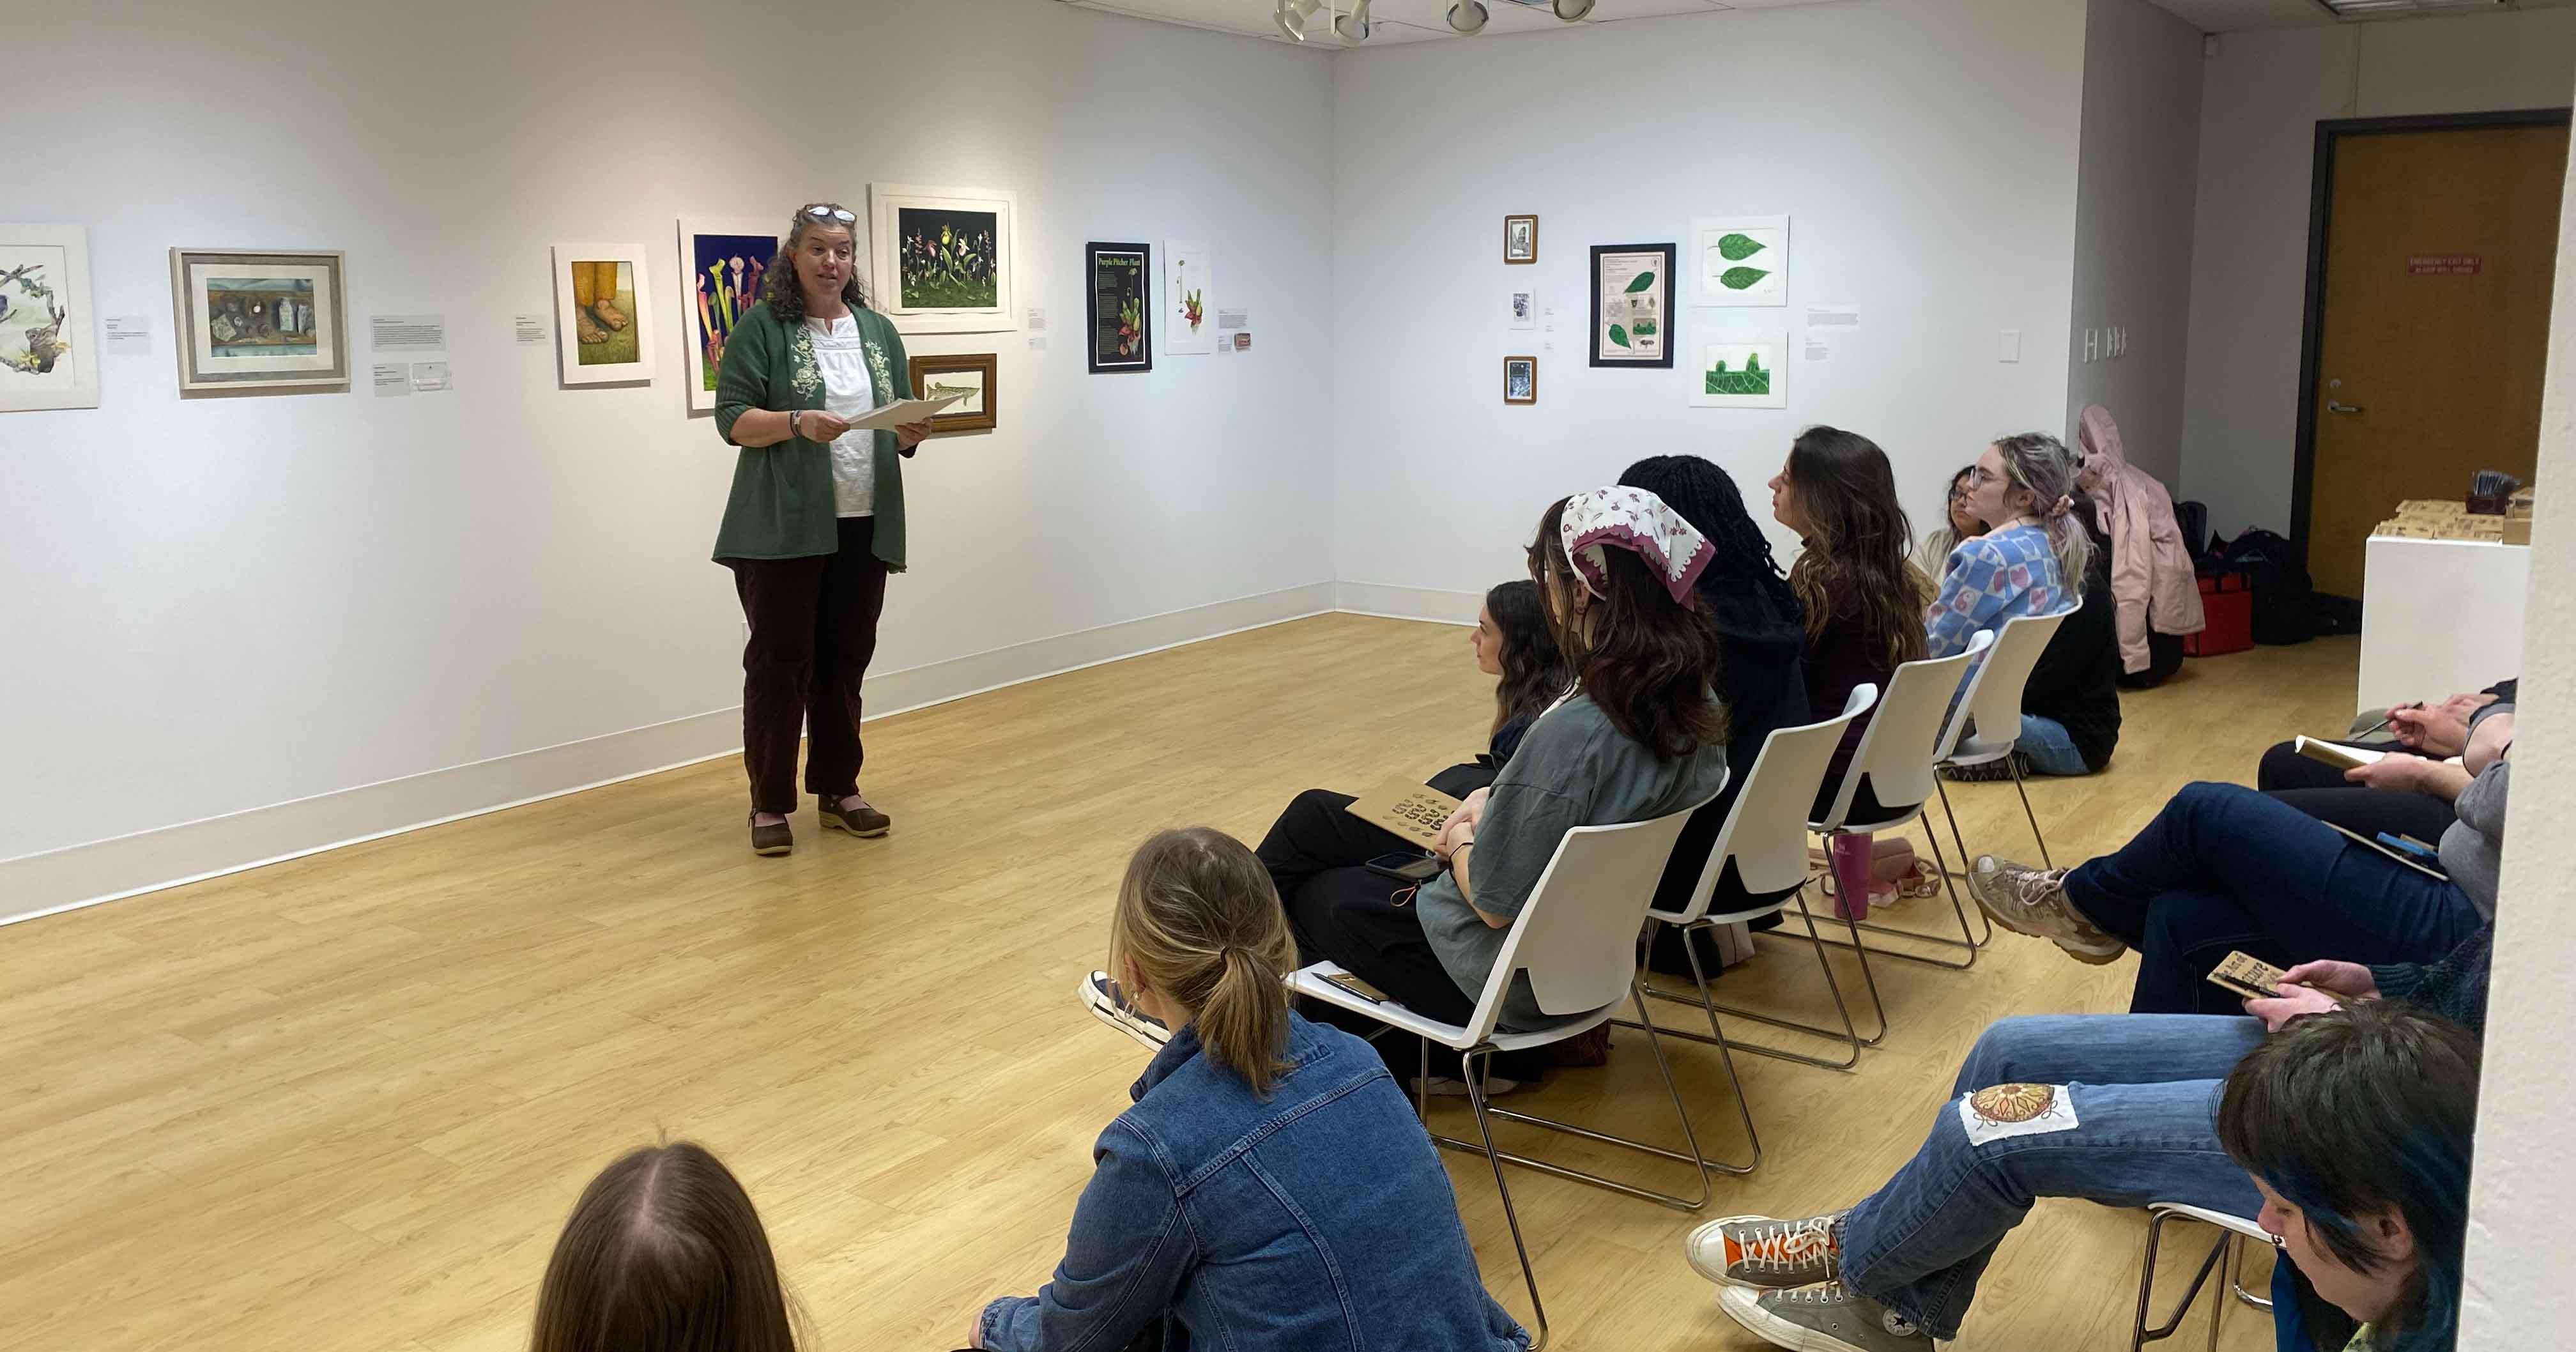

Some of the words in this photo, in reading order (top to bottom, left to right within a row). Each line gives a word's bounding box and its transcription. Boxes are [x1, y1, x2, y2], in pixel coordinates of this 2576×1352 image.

[1099, 257, 1112, 268] Purple
[1114, 257, 1128, 266] Pitcher
[1130, 257, 1140, 266] Plant
